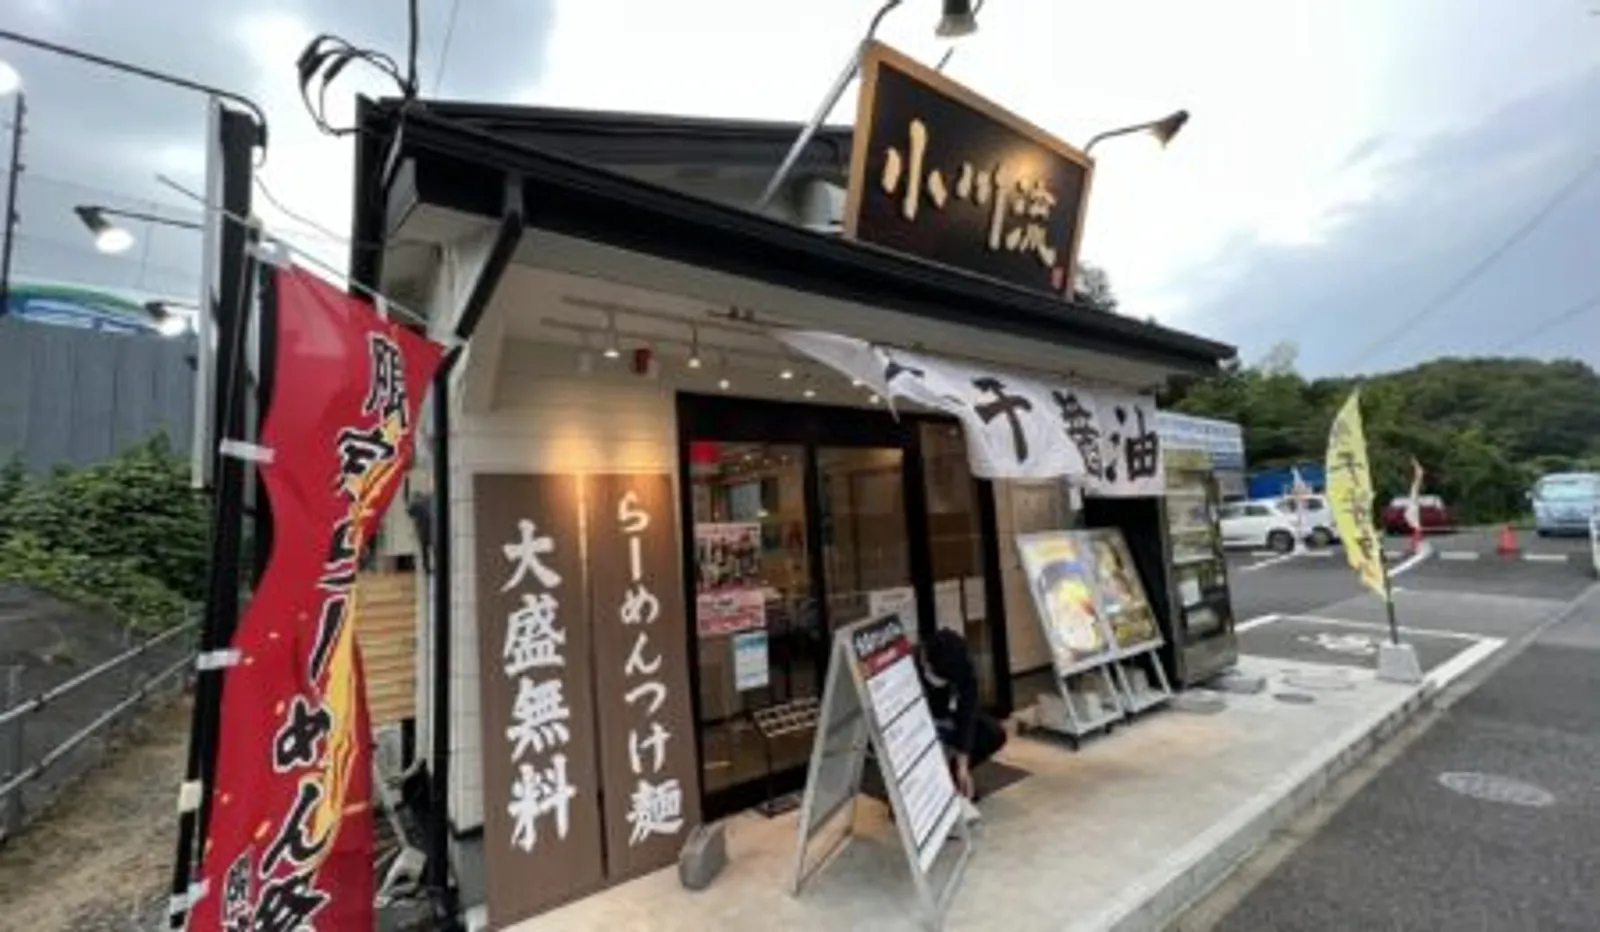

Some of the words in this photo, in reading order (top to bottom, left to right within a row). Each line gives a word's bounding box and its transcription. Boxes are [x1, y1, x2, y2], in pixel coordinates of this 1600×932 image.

[881, 118, 1057, 268] 小川流
[501, 518, 576, 852] 大盛無料
[617, 491, 684, 847] らーめんつけ麺
